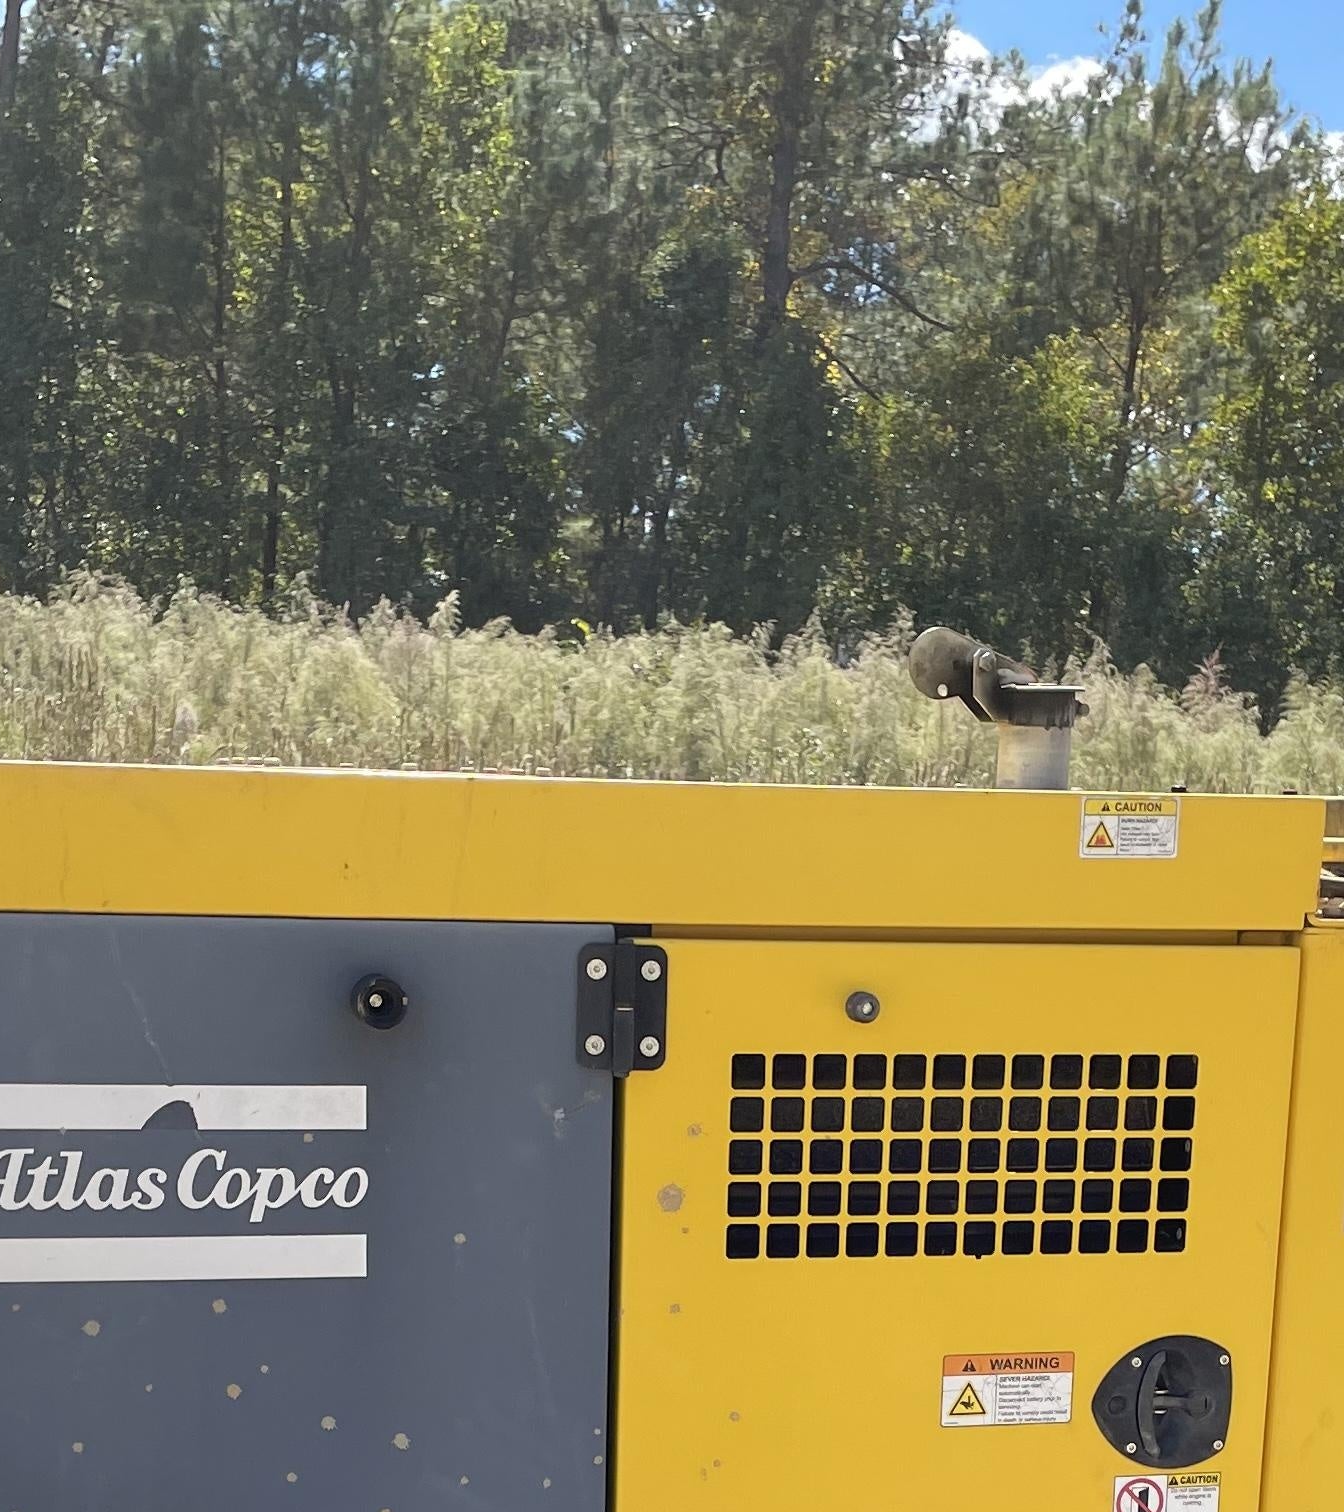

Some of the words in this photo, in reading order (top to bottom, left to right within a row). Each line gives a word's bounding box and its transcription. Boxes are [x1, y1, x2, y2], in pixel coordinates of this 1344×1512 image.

[1115, 803, 1162, 811] CAUTION
[176, 1147, 369, 1223] Copco
[989, 1357, 1060, 1370] WARNING
[1180, 1475, 1218, 1484] CAUTION
